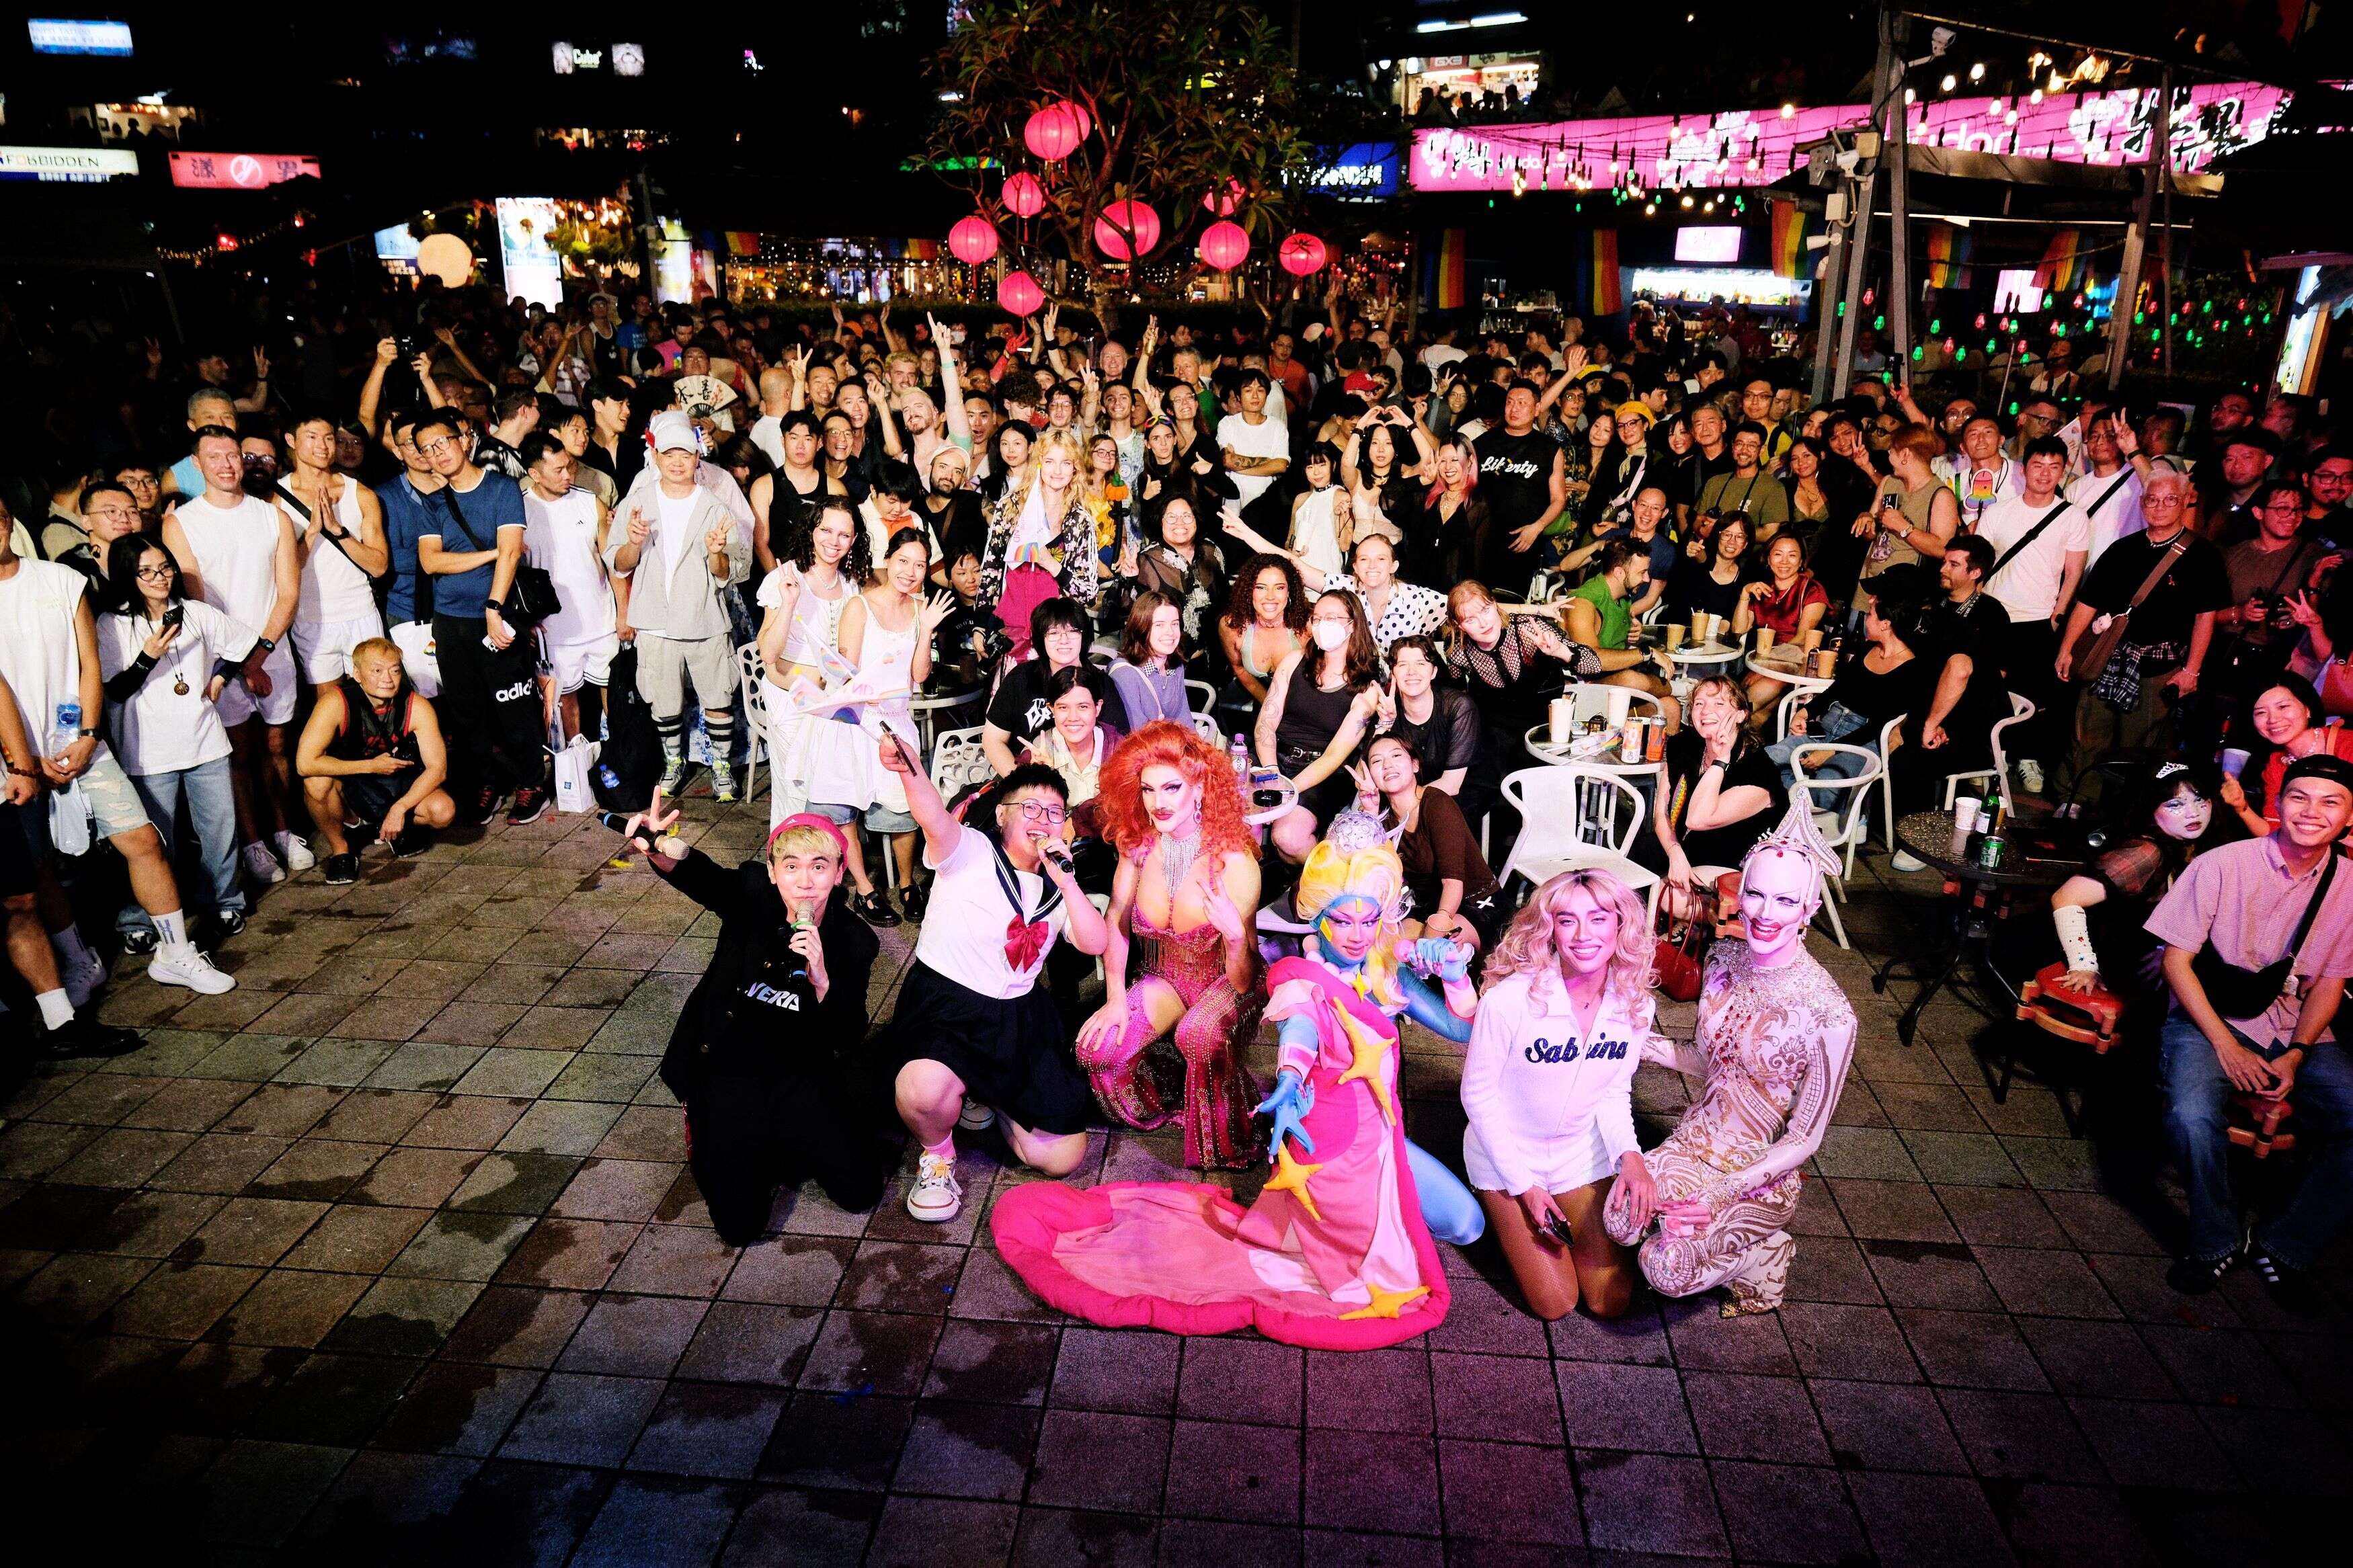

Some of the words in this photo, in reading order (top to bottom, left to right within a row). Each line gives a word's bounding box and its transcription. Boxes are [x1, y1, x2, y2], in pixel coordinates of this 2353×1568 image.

[1907, 122, 2020, 156] dan
[1500, 153, 1546, 170] Muda
[1525, 1032, 1629, 1063] Sabina
